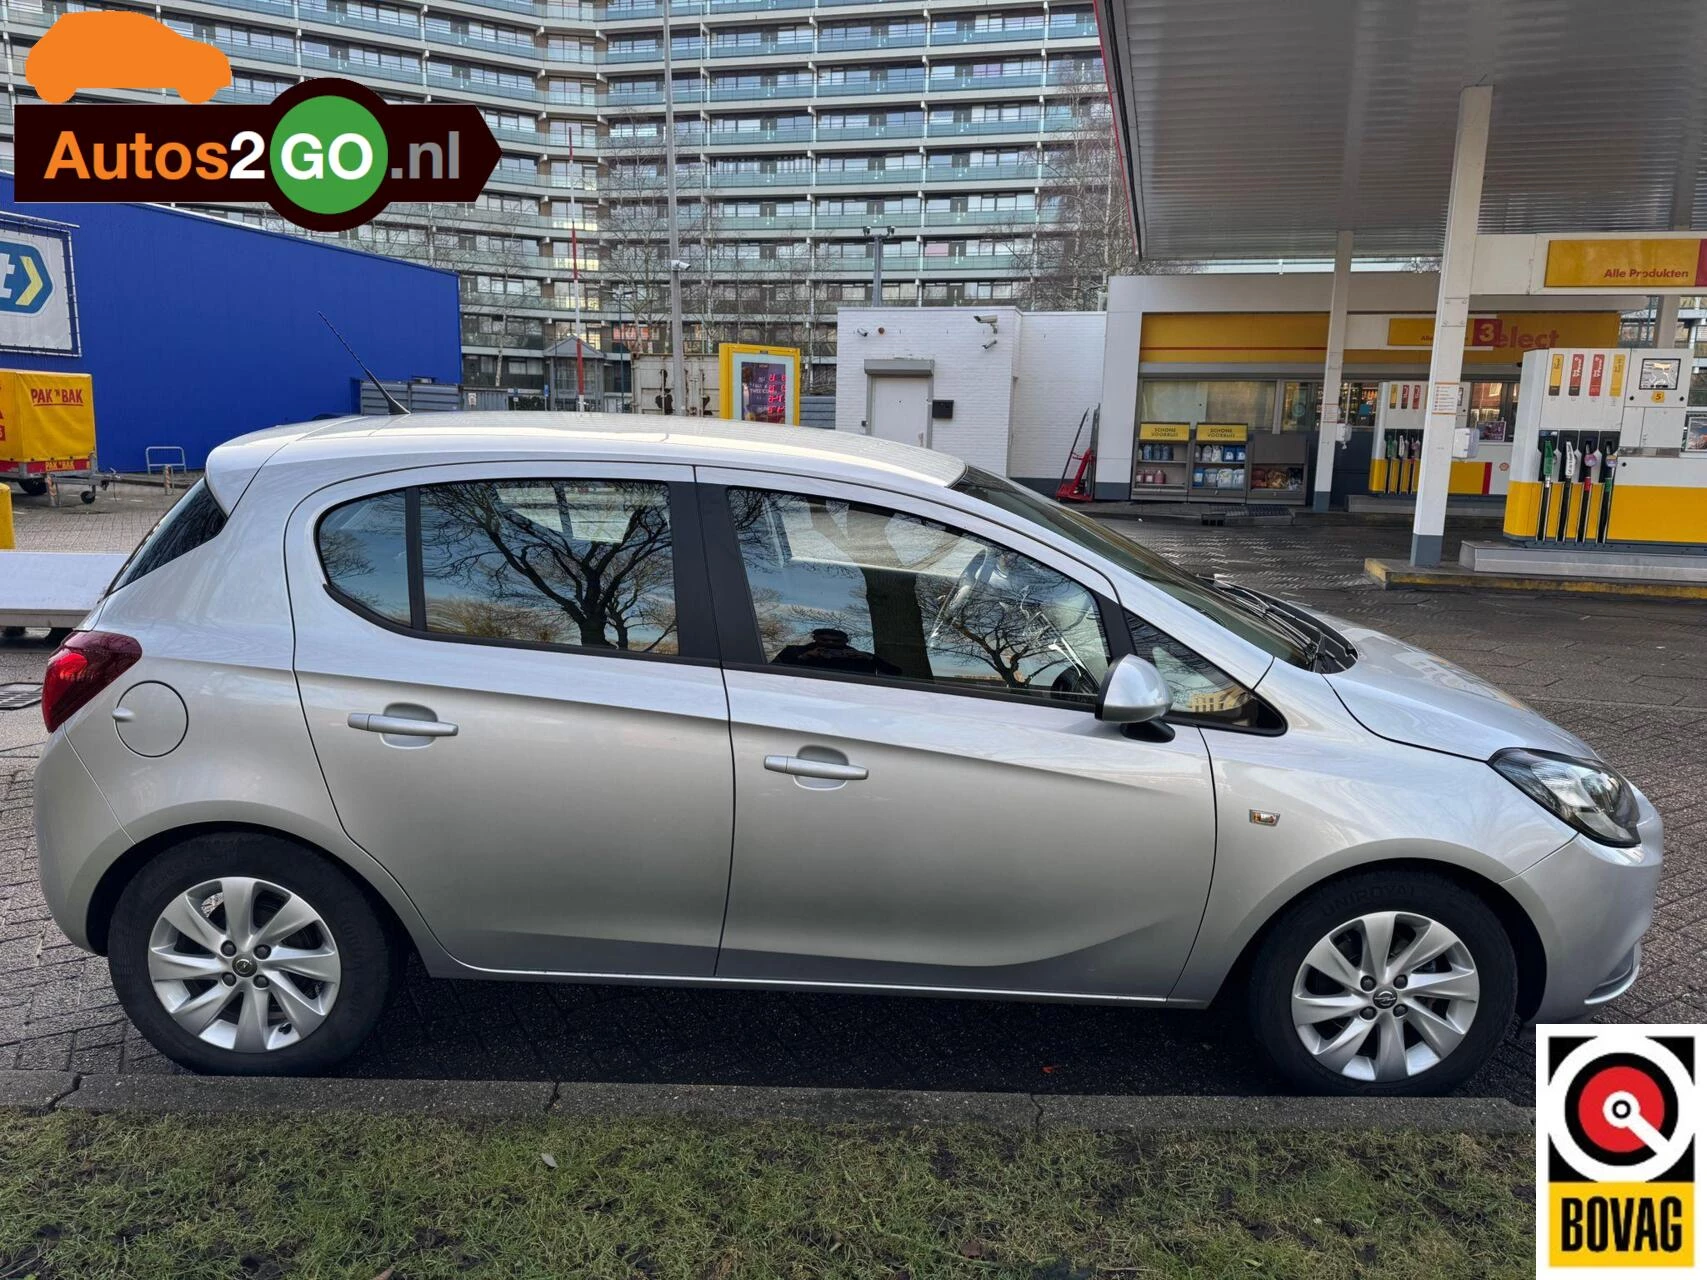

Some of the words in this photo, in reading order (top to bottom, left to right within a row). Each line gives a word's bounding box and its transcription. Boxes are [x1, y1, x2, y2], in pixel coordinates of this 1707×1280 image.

[1604, 268, 1626, 278] Alle
[1629, 268, 1689, 279] Produkten
[1479, 323, 1495, 342] 3
[1496, 326, 1559, 349] elect
[30, 388, 53, 403] PAK
[61, 388, 84, 403] BAK
